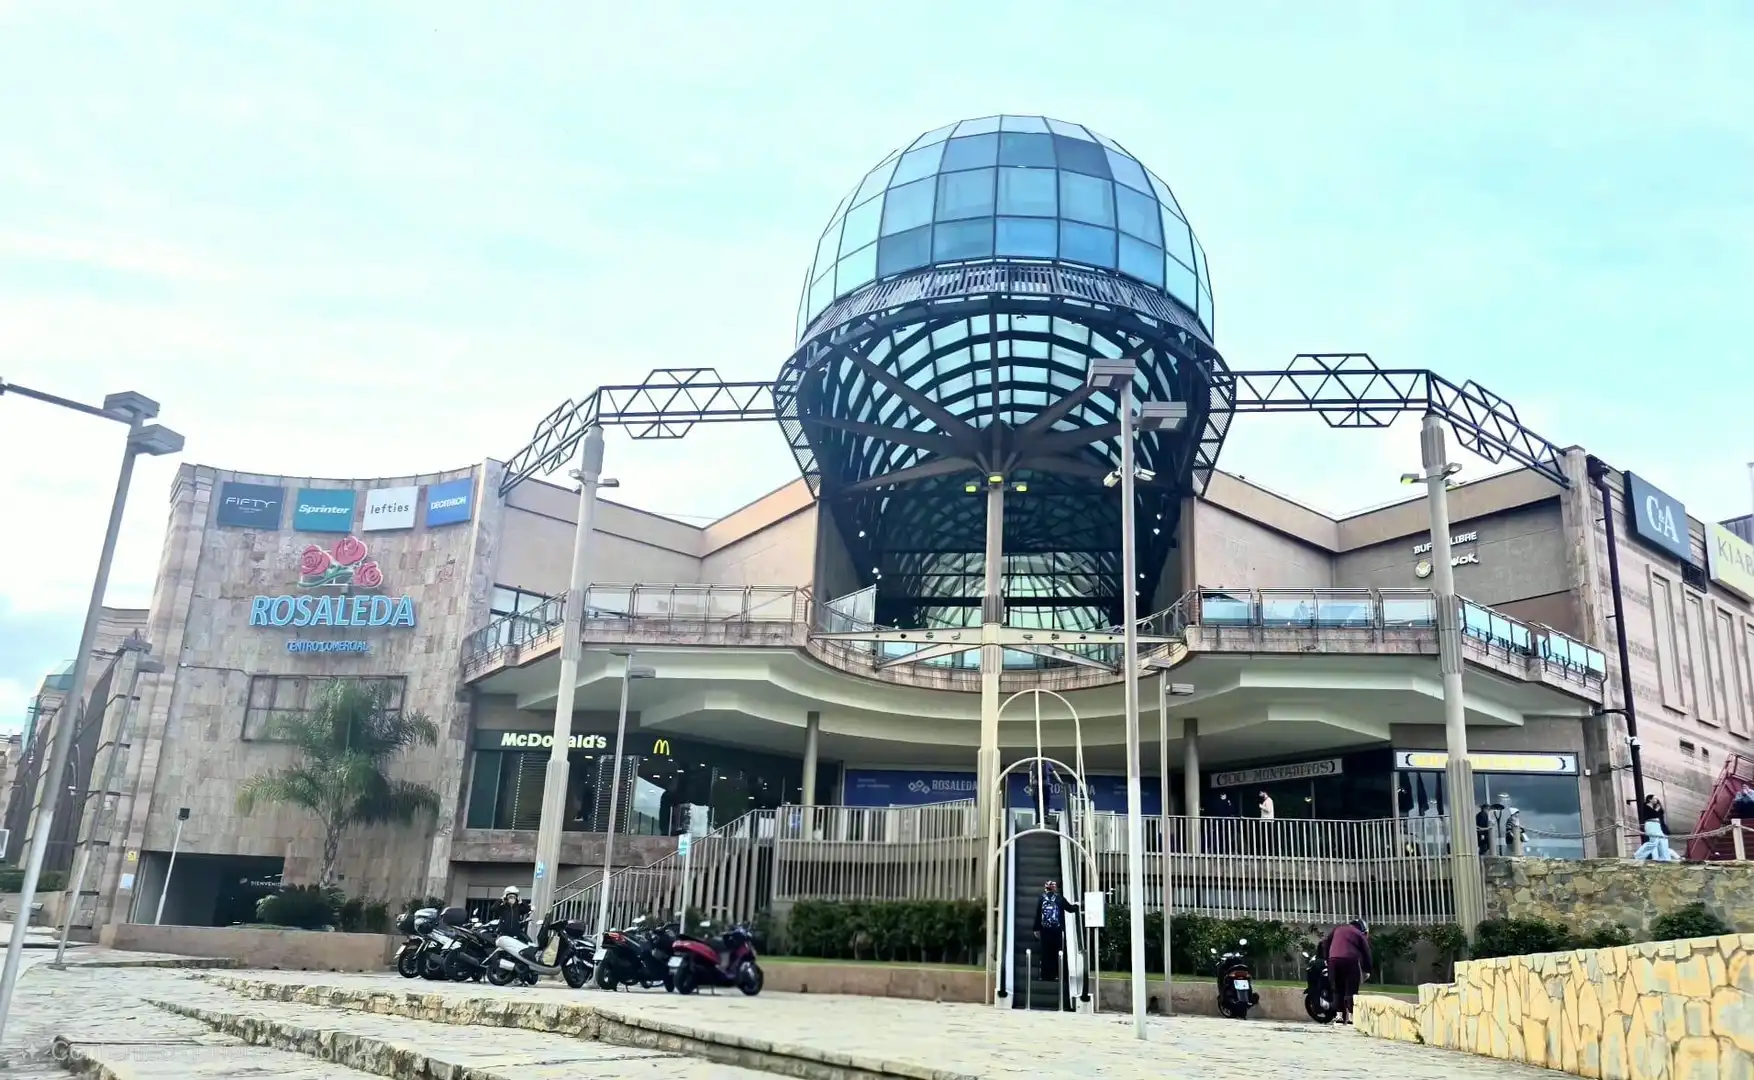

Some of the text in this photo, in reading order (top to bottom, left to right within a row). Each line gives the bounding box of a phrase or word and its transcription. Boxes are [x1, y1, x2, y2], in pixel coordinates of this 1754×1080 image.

[225, 496, 277, 507] FIFTY
[370, 500, 409, 514] lefties
[430, 496, 467, 510] DECATHLON
[298, 504, 351, 515] Sprinter
[1646, 495, 1680, 544] C&A
[1450, 531, 1477, 545] LIBRE
[1717, 535, 1754, 578] KIAB
[249, 594, 416, 627] ROSALEDA
[501, 733, 607, 749] McDoald's
[931, 780, 978, 791] ROSALEDA
